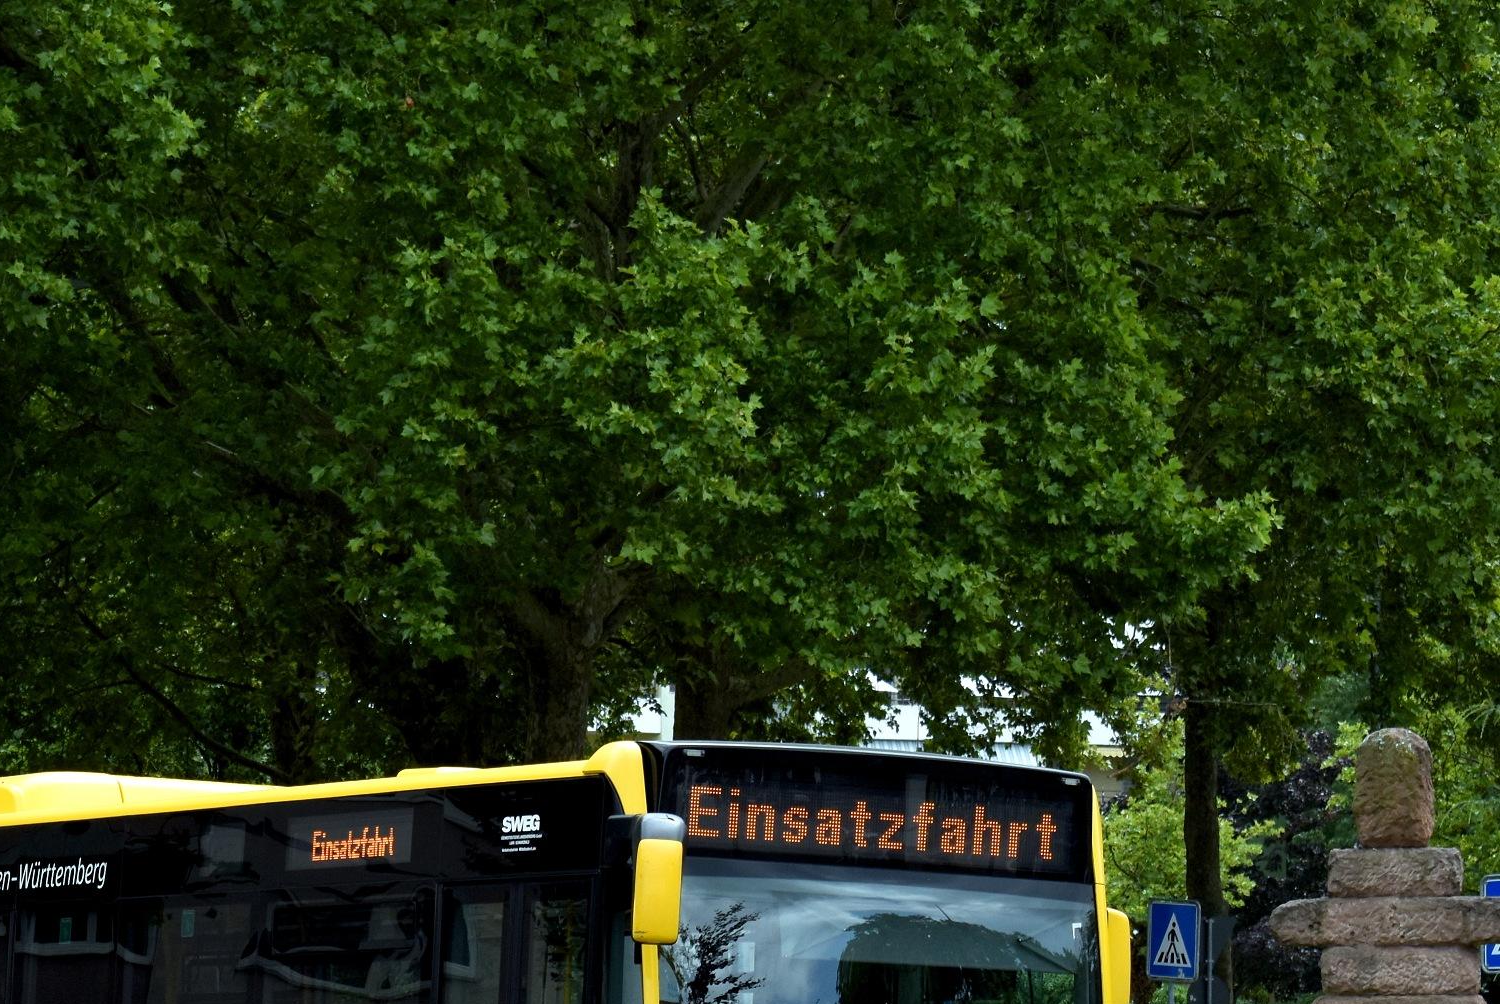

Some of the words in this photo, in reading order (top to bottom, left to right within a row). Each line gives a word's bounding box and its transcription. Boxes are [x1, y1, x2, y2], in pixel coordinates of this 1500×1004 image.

[501, 814, 541, 833] SWEG
[688, 785, 1057, 861] Einsatzfahrt
[312, 826, 394, 861] Einsatzfahrt
